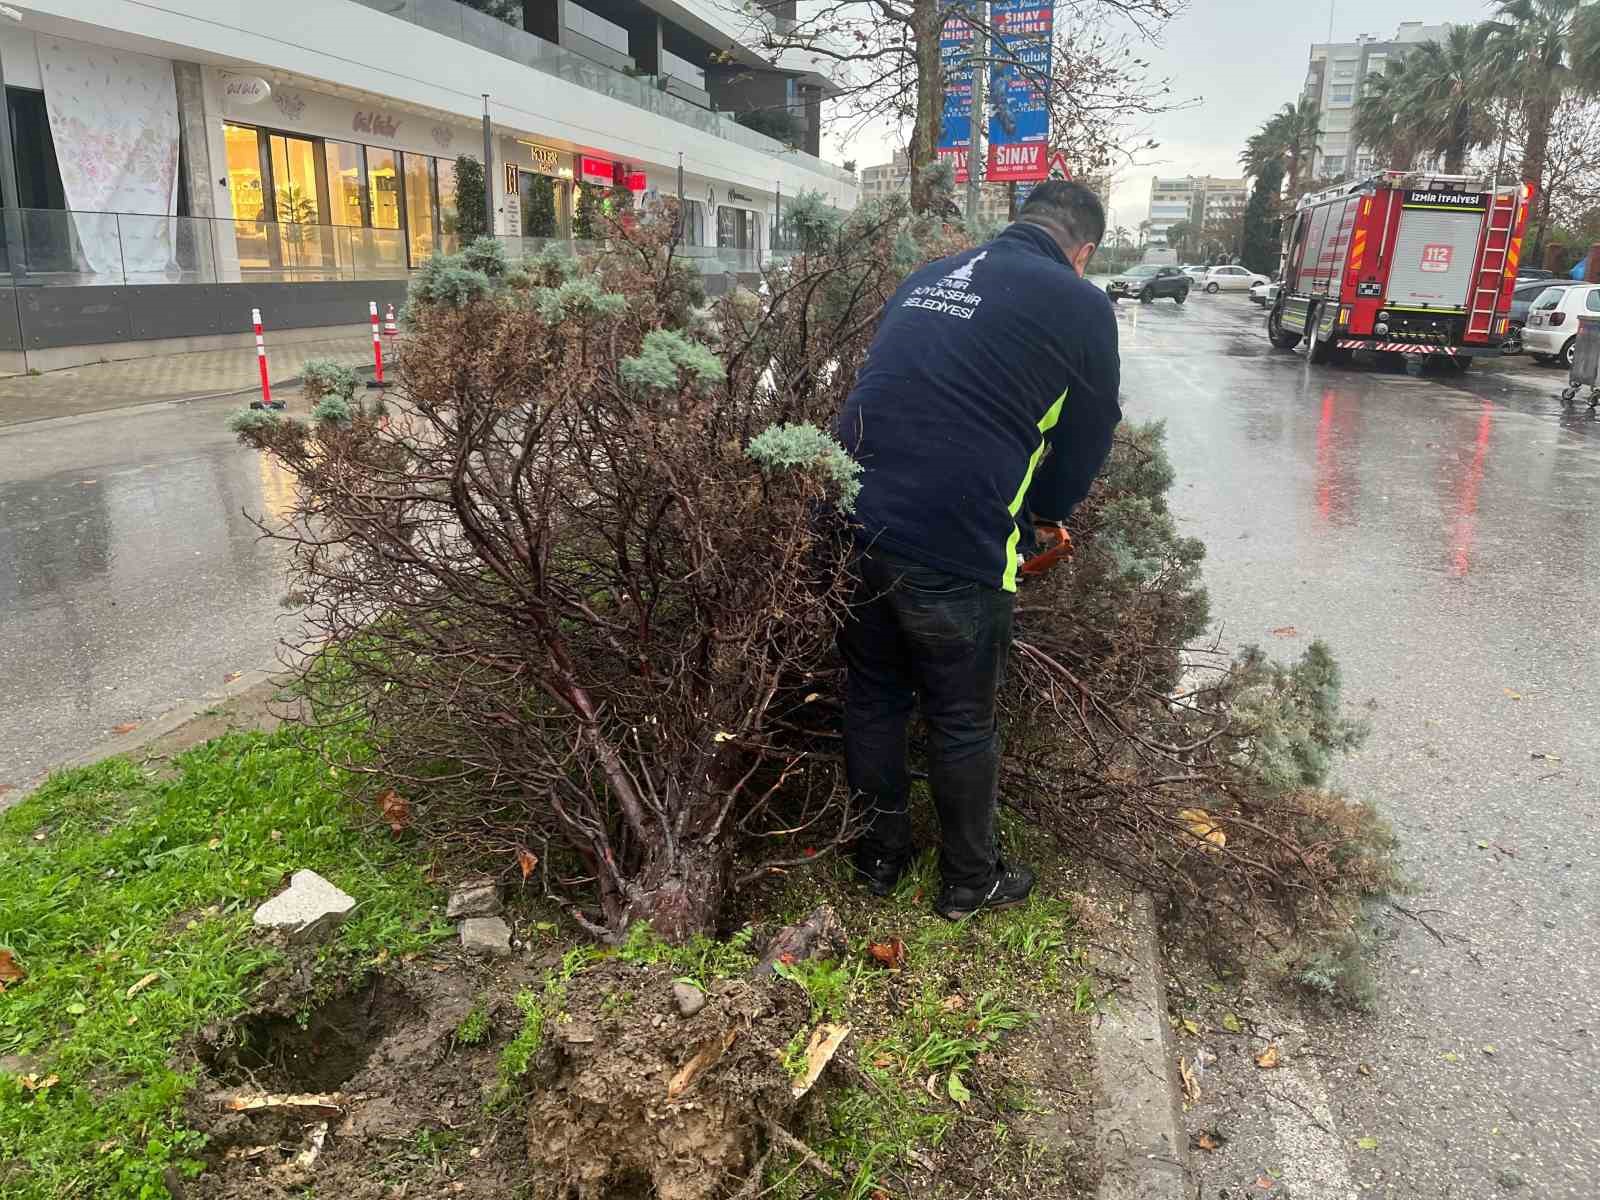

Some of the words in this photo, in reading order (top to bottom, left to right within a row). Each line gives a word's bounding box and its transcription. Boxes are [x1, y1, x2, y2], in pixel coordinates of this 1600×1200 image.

[996, 145, 1039, 166] SINAV
[1411, 192, 1436, 202] İZMİR
[1437, 193, 1480, 206] İTFAİYESİ
[1427, 247, 1449, 261] 112
